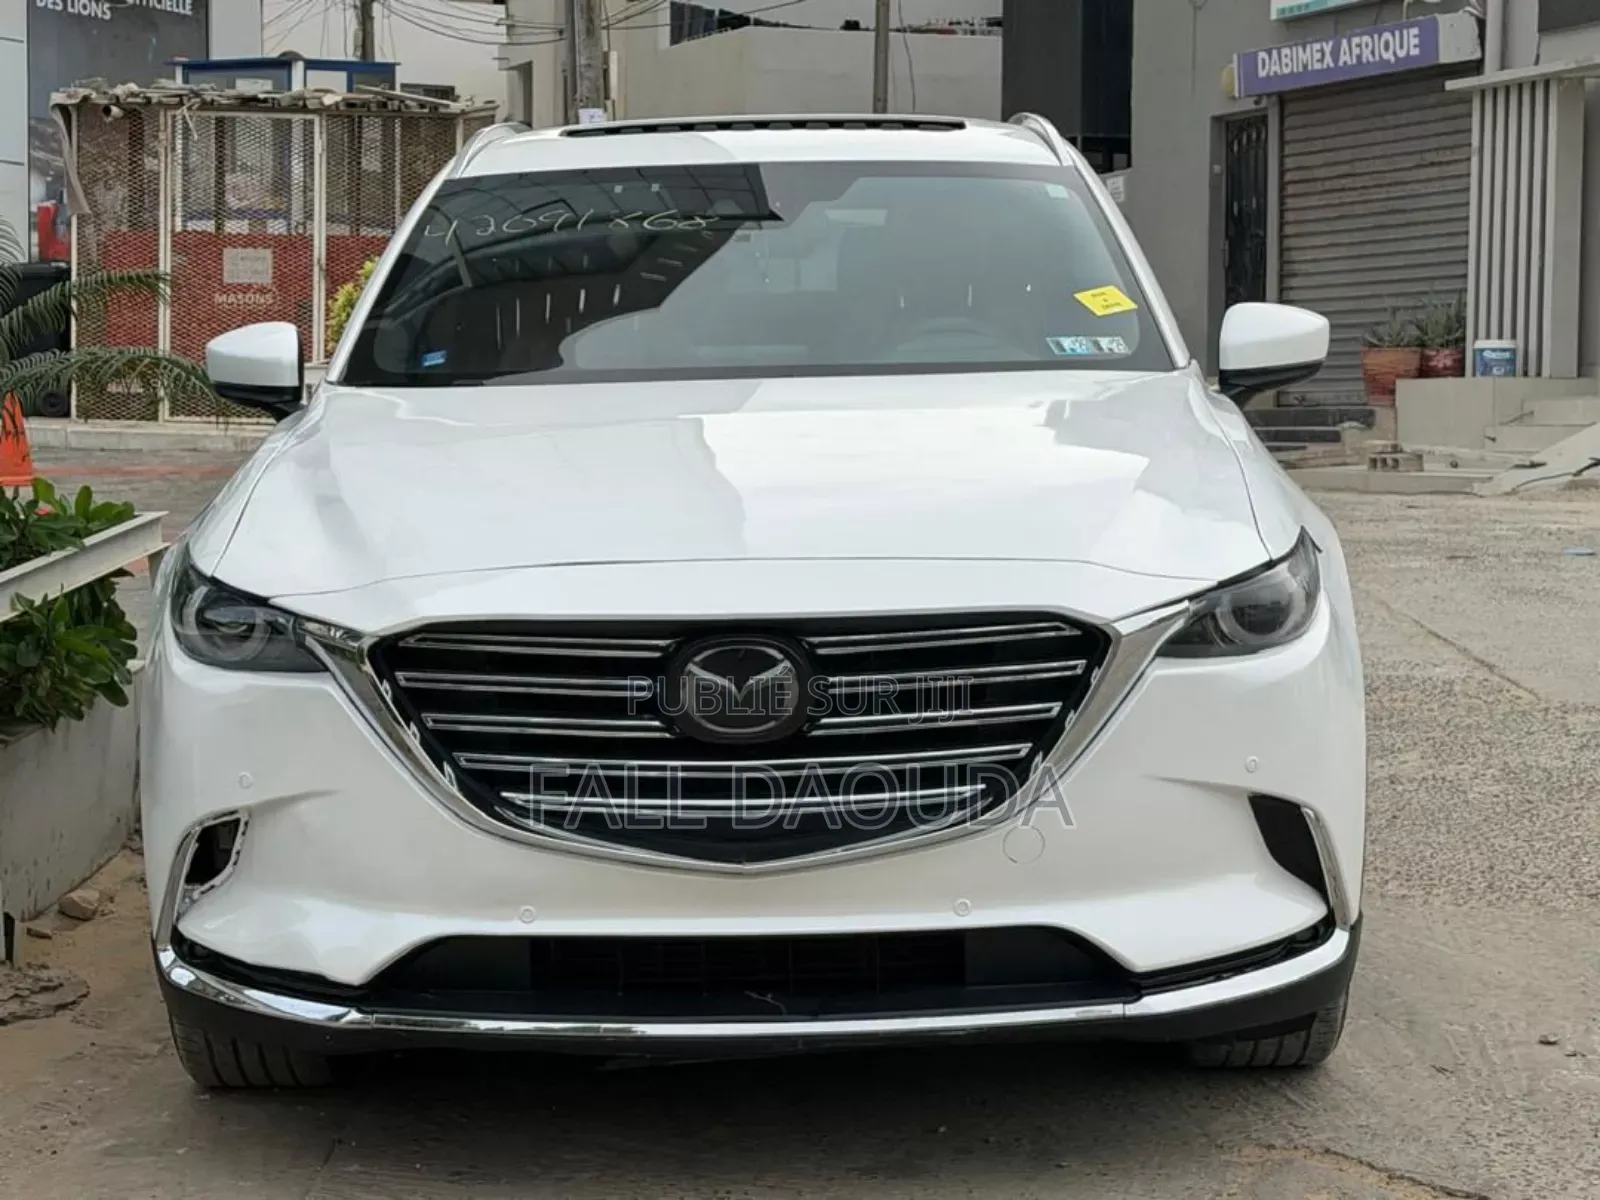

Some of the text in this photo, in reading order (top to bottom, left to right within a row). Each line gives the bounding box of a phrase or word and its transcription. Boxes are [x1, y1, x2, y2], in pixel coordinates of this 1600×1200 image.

[67, 0, 112, 20] LIONS
[1256, 27, 1420, 78] DABIMEX AFRIQUE
